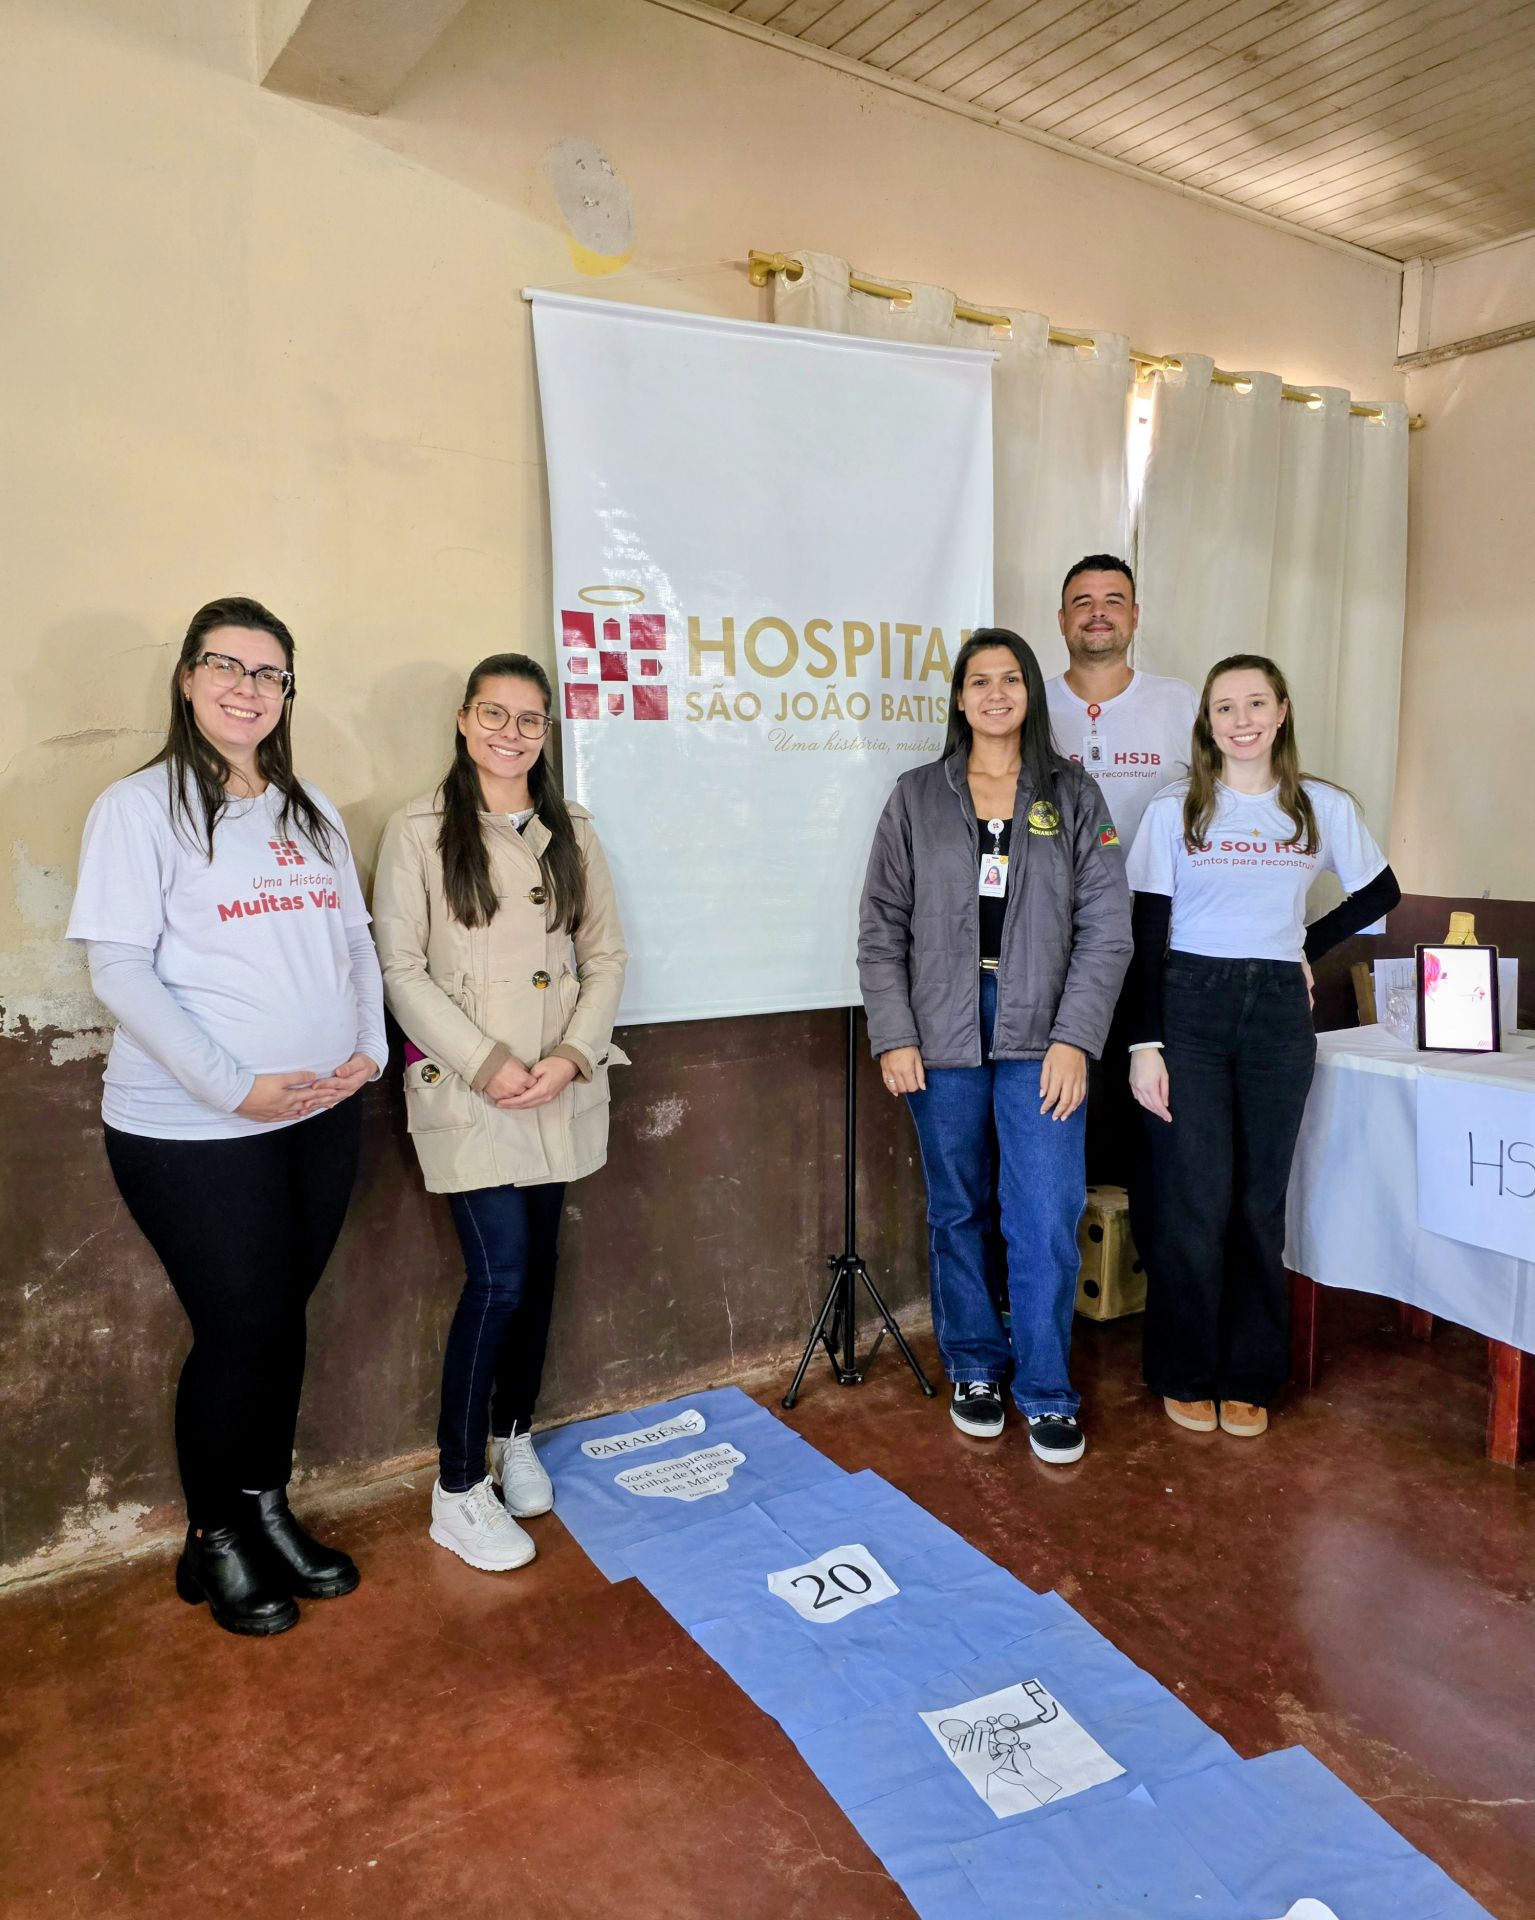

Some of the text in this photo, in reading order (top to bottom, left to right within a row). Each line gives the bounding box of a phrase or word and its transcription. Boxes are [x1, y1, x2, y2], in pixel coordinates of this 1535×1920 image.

[685, 682, 762, 722] SÃO
[774, 683, 870, 721] JOÃO
[767, 727, 943, 755] Uma história, muitas
[1114, 752, 1161, 766] HSJB
[1102, 769, 1157, 779] reconstruir!
[1220, 841, 1267, 853] SOU
[1191, 857, 1229, 868] Juntos
[1231, 858, 1258, 866] para
[252, 873, 333, 890] Uma História
[217, 892, 305, 922] Muitas
[588, 1419, 698, 1456] PARABÉNS
[620, 1470, 653, 1484] Você
[656, 1451, 721, 1475] completou
[628, 1476, 671, 1492] Trilha
[672, 1470, 688, 1480] de
[690, 1456, 739, 1476] Higiene
[663, 1484, 687, 1494] das
[790, 1563, 873, 1610] 20
